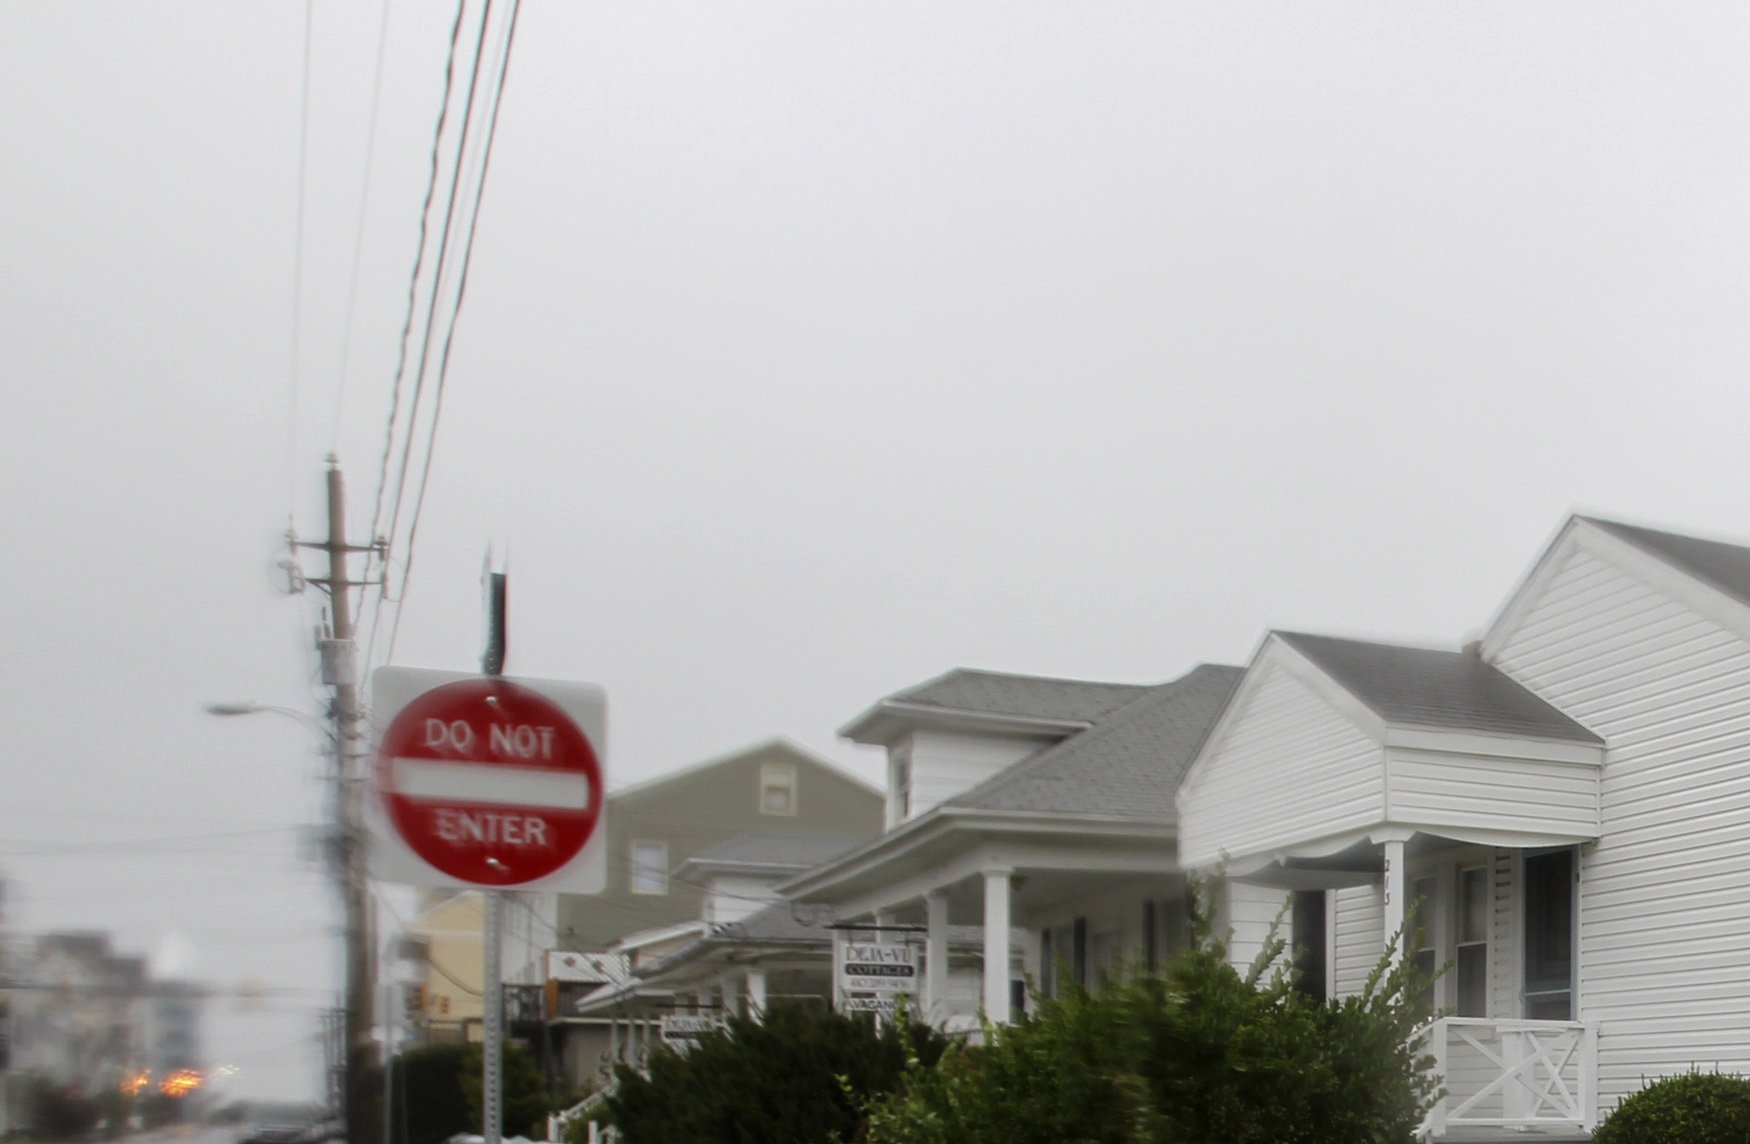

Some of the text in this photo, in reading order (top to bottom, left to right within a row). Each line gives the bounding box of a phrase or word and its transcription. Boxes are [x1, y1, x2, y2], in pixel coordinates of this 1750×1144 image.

[424, 718, 555, 759] DO NOT
[433, 808, 547, 845] ENTER
[846, 946, 912, 963] DEJA-VU
